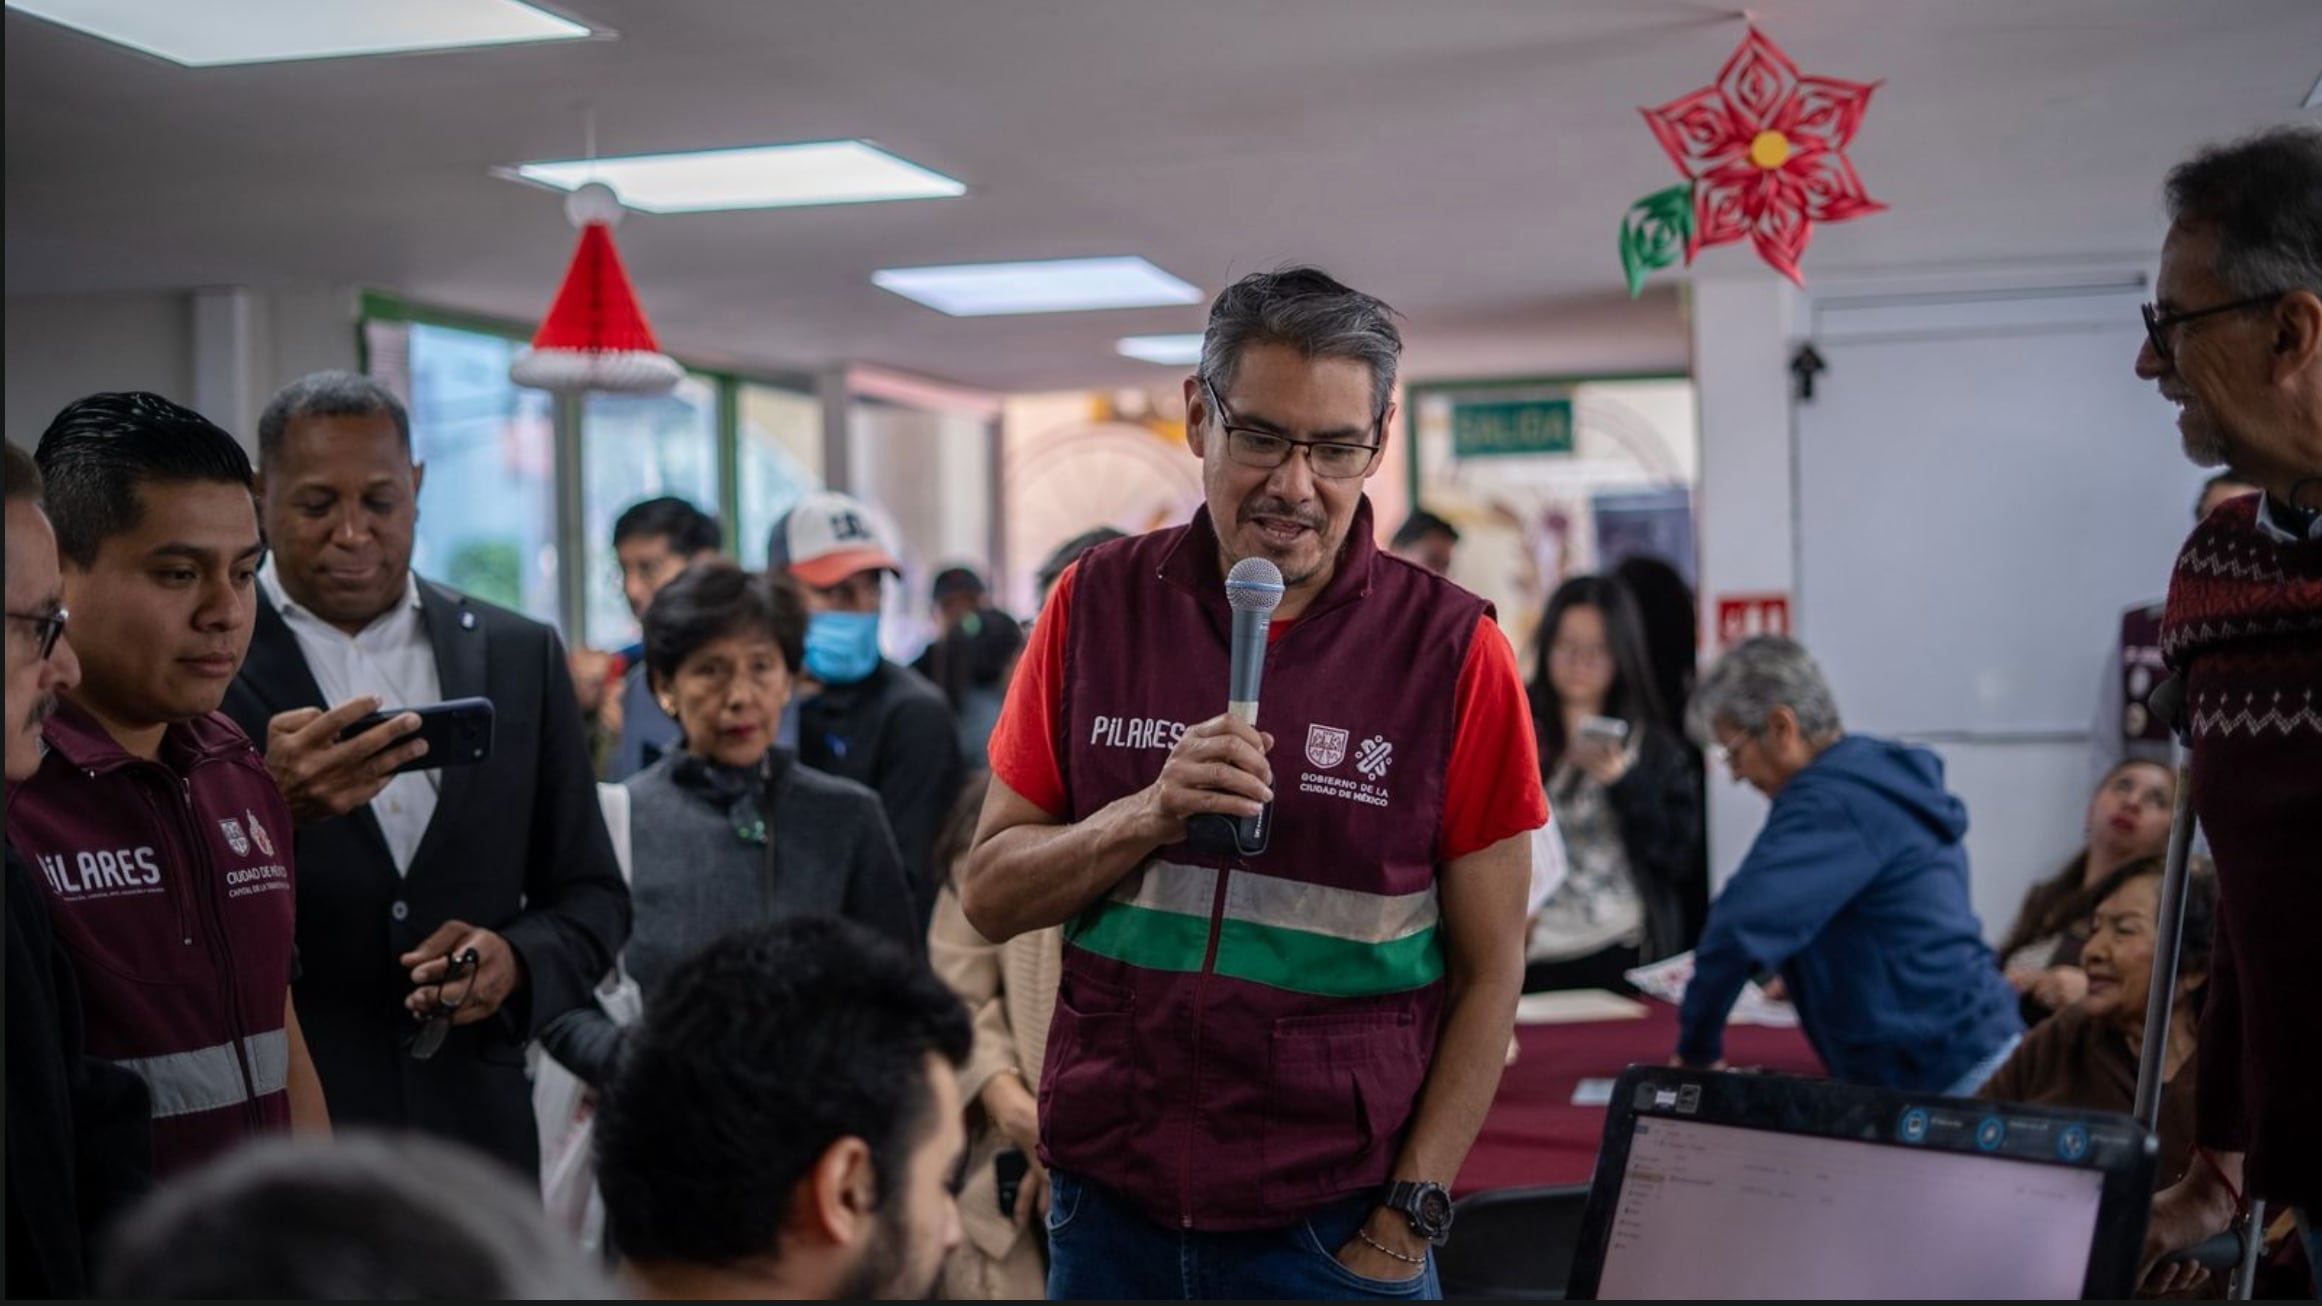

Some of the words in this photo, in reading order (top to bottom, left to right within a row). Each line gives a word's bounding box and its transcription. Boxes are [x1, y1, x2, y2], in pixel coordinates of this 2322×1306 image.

[1300, 783, 1337, 796] CIUDAD
[1338, 789, 1352, 799] DE
[1353, 791, 1388, 807] MÉXICO
[1301, 772, 1357, 790] GOBIERNO
[1360, 783, 1374, 794] DE
[1376, 787, 1388, 798] LA
